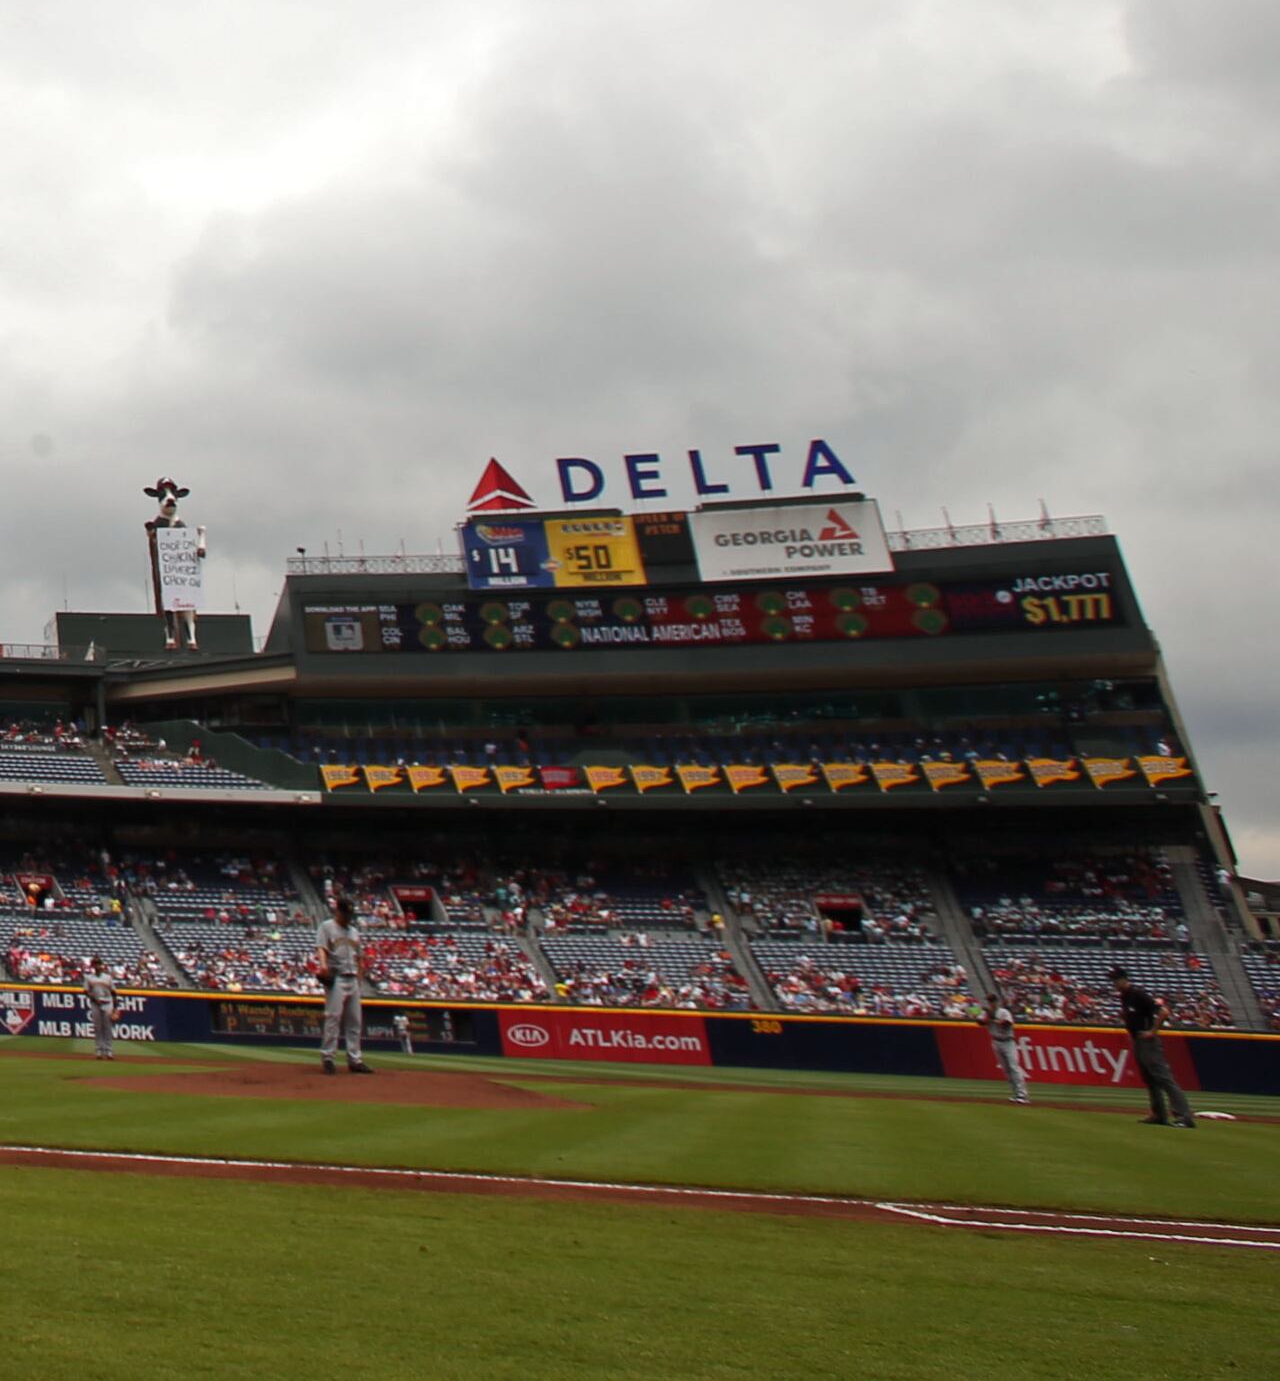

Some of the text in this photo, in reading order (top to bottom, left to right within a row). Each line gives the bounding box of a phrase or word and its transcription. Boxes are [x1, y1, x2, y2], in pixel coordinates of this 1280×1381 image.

[554, 438, 857, 504] DELTA
[714, 528, 815, 548] GEORGIA
[487, 547, 520, 574] 14
[574, 544, 613, 571] 50
[784, 542, 865, 559] POWER
[1011, 572, 1111, 593] JACKPOT
[1020, 593, 1112, 625] $1,777
[579, 622, 721, 644] NATIONAL AMERICAN
[41, 992, 75, 1009] MLB
[38, 1020, 155, 1041] MLB NEWORK
[367, 1026, 394, 1037] MPH
[514, 1028, 542, 1043] KIA
[750, 1020, 783, 1035] 380
[568, 1027, 703, 1052] ATLKia.com
